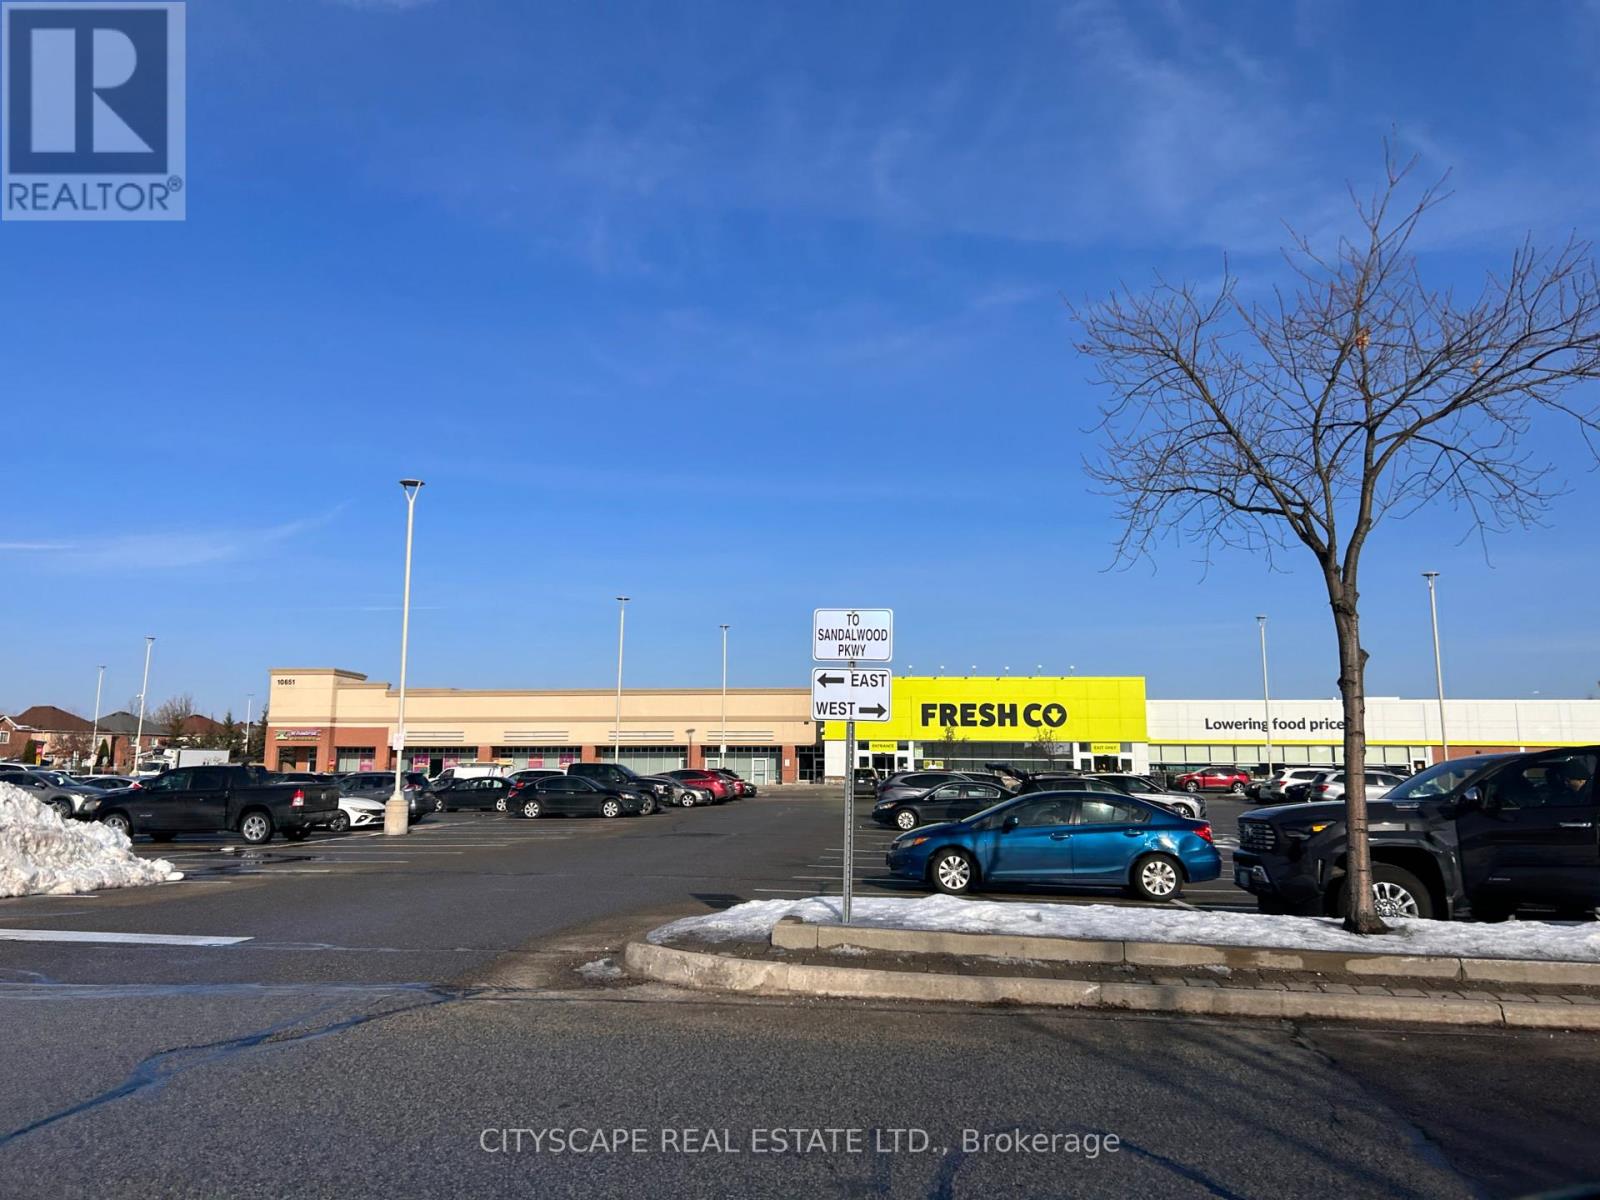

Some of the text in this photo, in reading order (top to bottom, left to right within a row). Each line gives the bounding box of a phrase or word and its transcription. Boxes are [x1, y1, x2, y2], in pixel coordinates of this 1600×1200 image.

[846, 613, 860, 626] TO
[817, 628, 888, 641] SANDALWOOD
[838, 644, 867, 657] PKWY
[851, 673, 887, 688] EAST
[816, 701, 856, 716] WEST
[921, 702, 1018, 727] FRESH
[1205, 717, 1345, 732] Lowering food price
